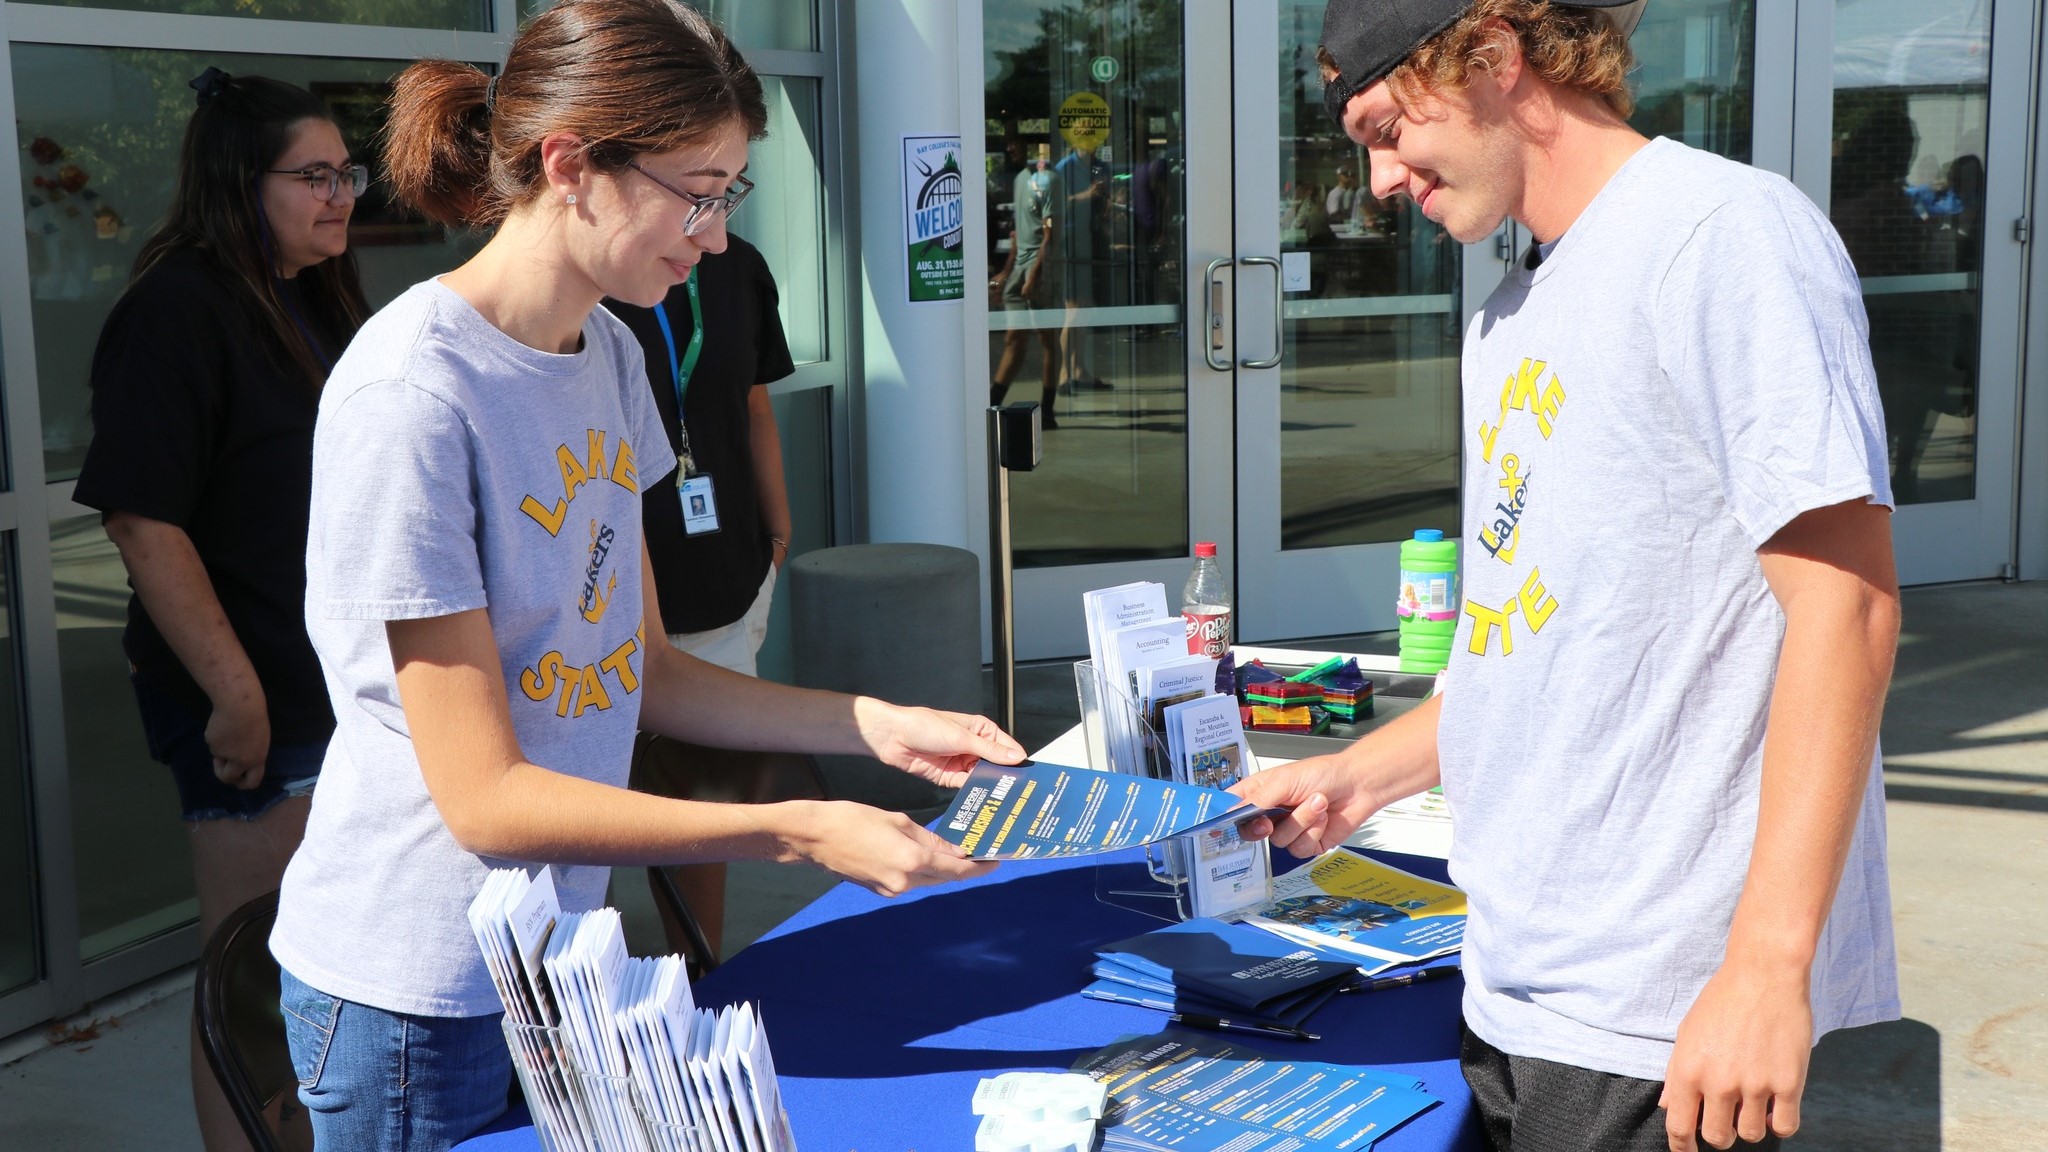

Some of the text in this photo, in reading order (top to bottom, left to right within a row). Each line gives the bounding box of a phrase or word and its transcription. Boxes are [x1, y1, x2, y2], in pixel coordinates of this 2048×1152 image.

[1060, 117, 1109, 127] CAUTION
[917, 145, 928, 154] BAY
[915, 196, 962, 239] WELCO
[916, 261, 934, 271] AUG.
[920, 271, 942, 279] OUTSIDE
[519, 428, 638, 538] LAKE
[578, 523, 615, 622] Lakers
[1123, 602, 1145, 611] Business
[1116, 608, 1154, 620] Administration
[1120, 616, 1152, 626] Management
[1215, 617, 1227, 630] Dr
[1135, 637, 1169, 650] Accounting
[1211, 645, 1219, 653] 23
[519, 616, 645, 719] STAT
[1159, 675, 1204, 689] Criminal Justice
[1199, 714, 1219, 726] Escanaba
[1195, 721, 1229, 735] Iron Mountain
[1194, 729, 1233, 744] Regional Centers
[990, 774, 1017, 801] AWARDS
[954, 786, 983, 823] LAKE SUPERIOR
[964, 788, 990, 824] STATE UNIVERSITY
[1280, 856, 1350, 886] SUPERIOR
[1140, 1042, 1181, 1062] AWARDS
